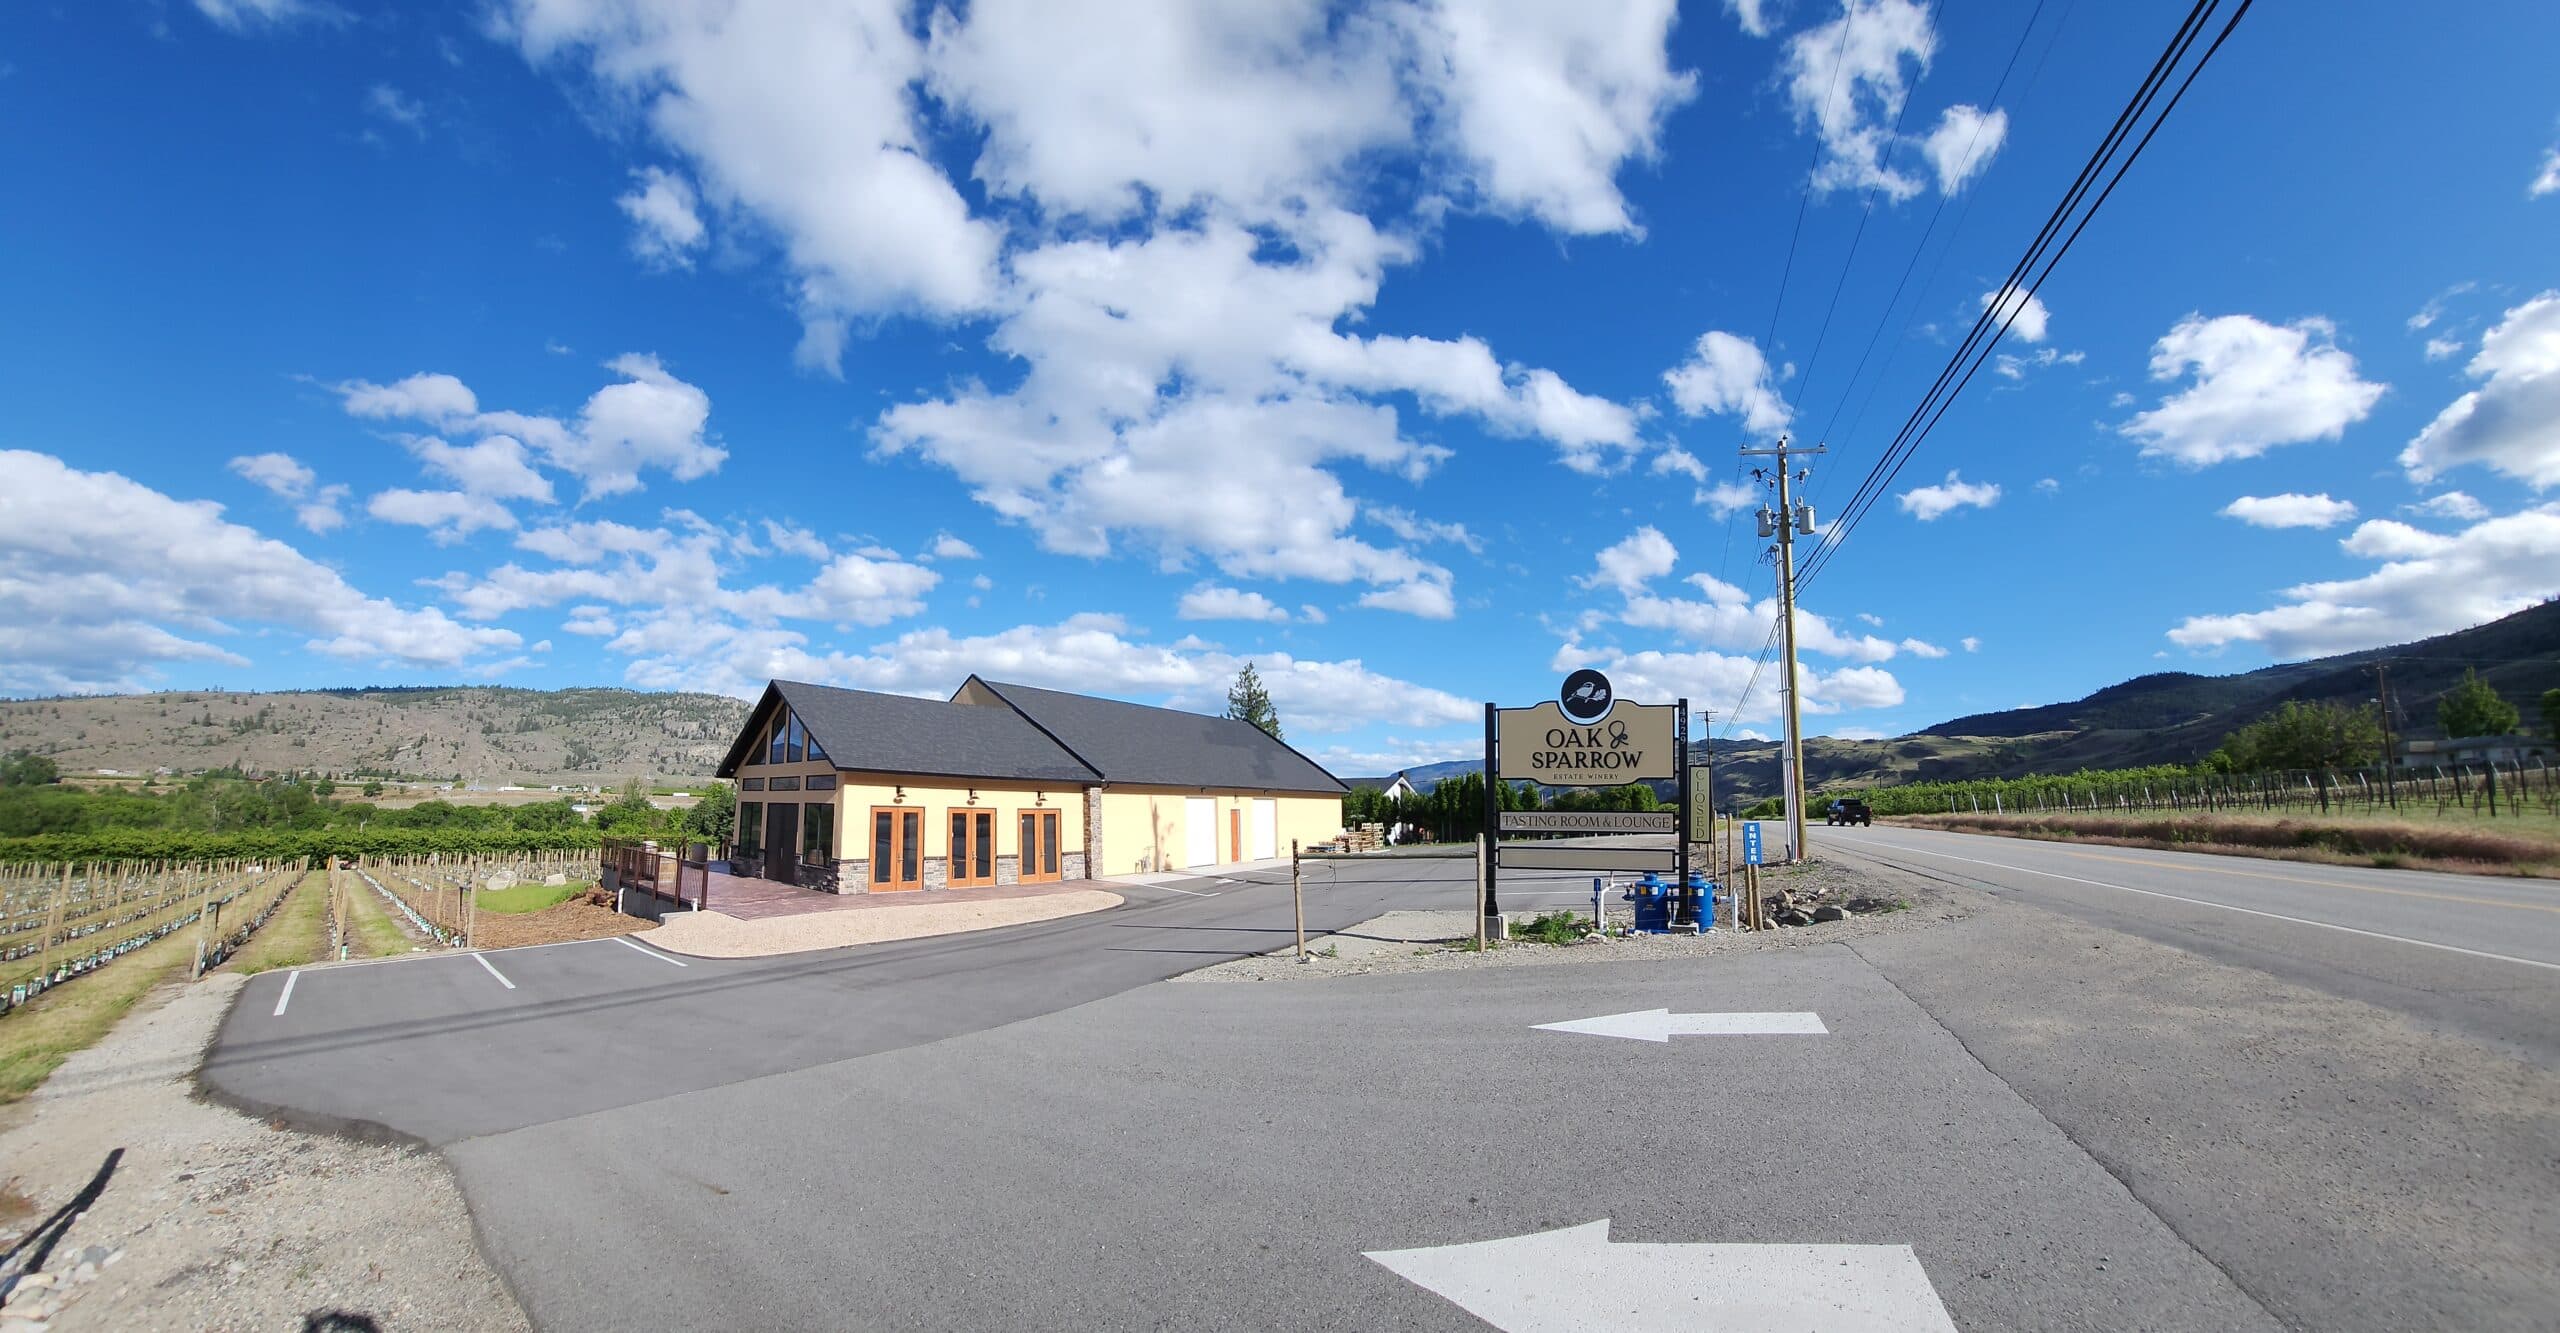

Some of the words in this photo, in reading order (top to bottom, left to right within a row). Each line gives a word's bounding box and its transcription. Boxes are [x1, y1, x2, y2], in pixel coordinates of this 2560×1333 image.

[1546, 728, 1604, 748] OAK
[1608, 720, 1629, 749] &
[1531, 750, 1643, 769] SPARROW
[1694, 769, 1706, 839] CLOSED
[1502, 814, 1557, 828] TASTING
[1560, 815, 1601, 828] ROOM
[1602, 817, 1612, 828] &
[1614, 816, 1671, 829] LOUNGE
[1749, 825, 1758, 862] ENTER
